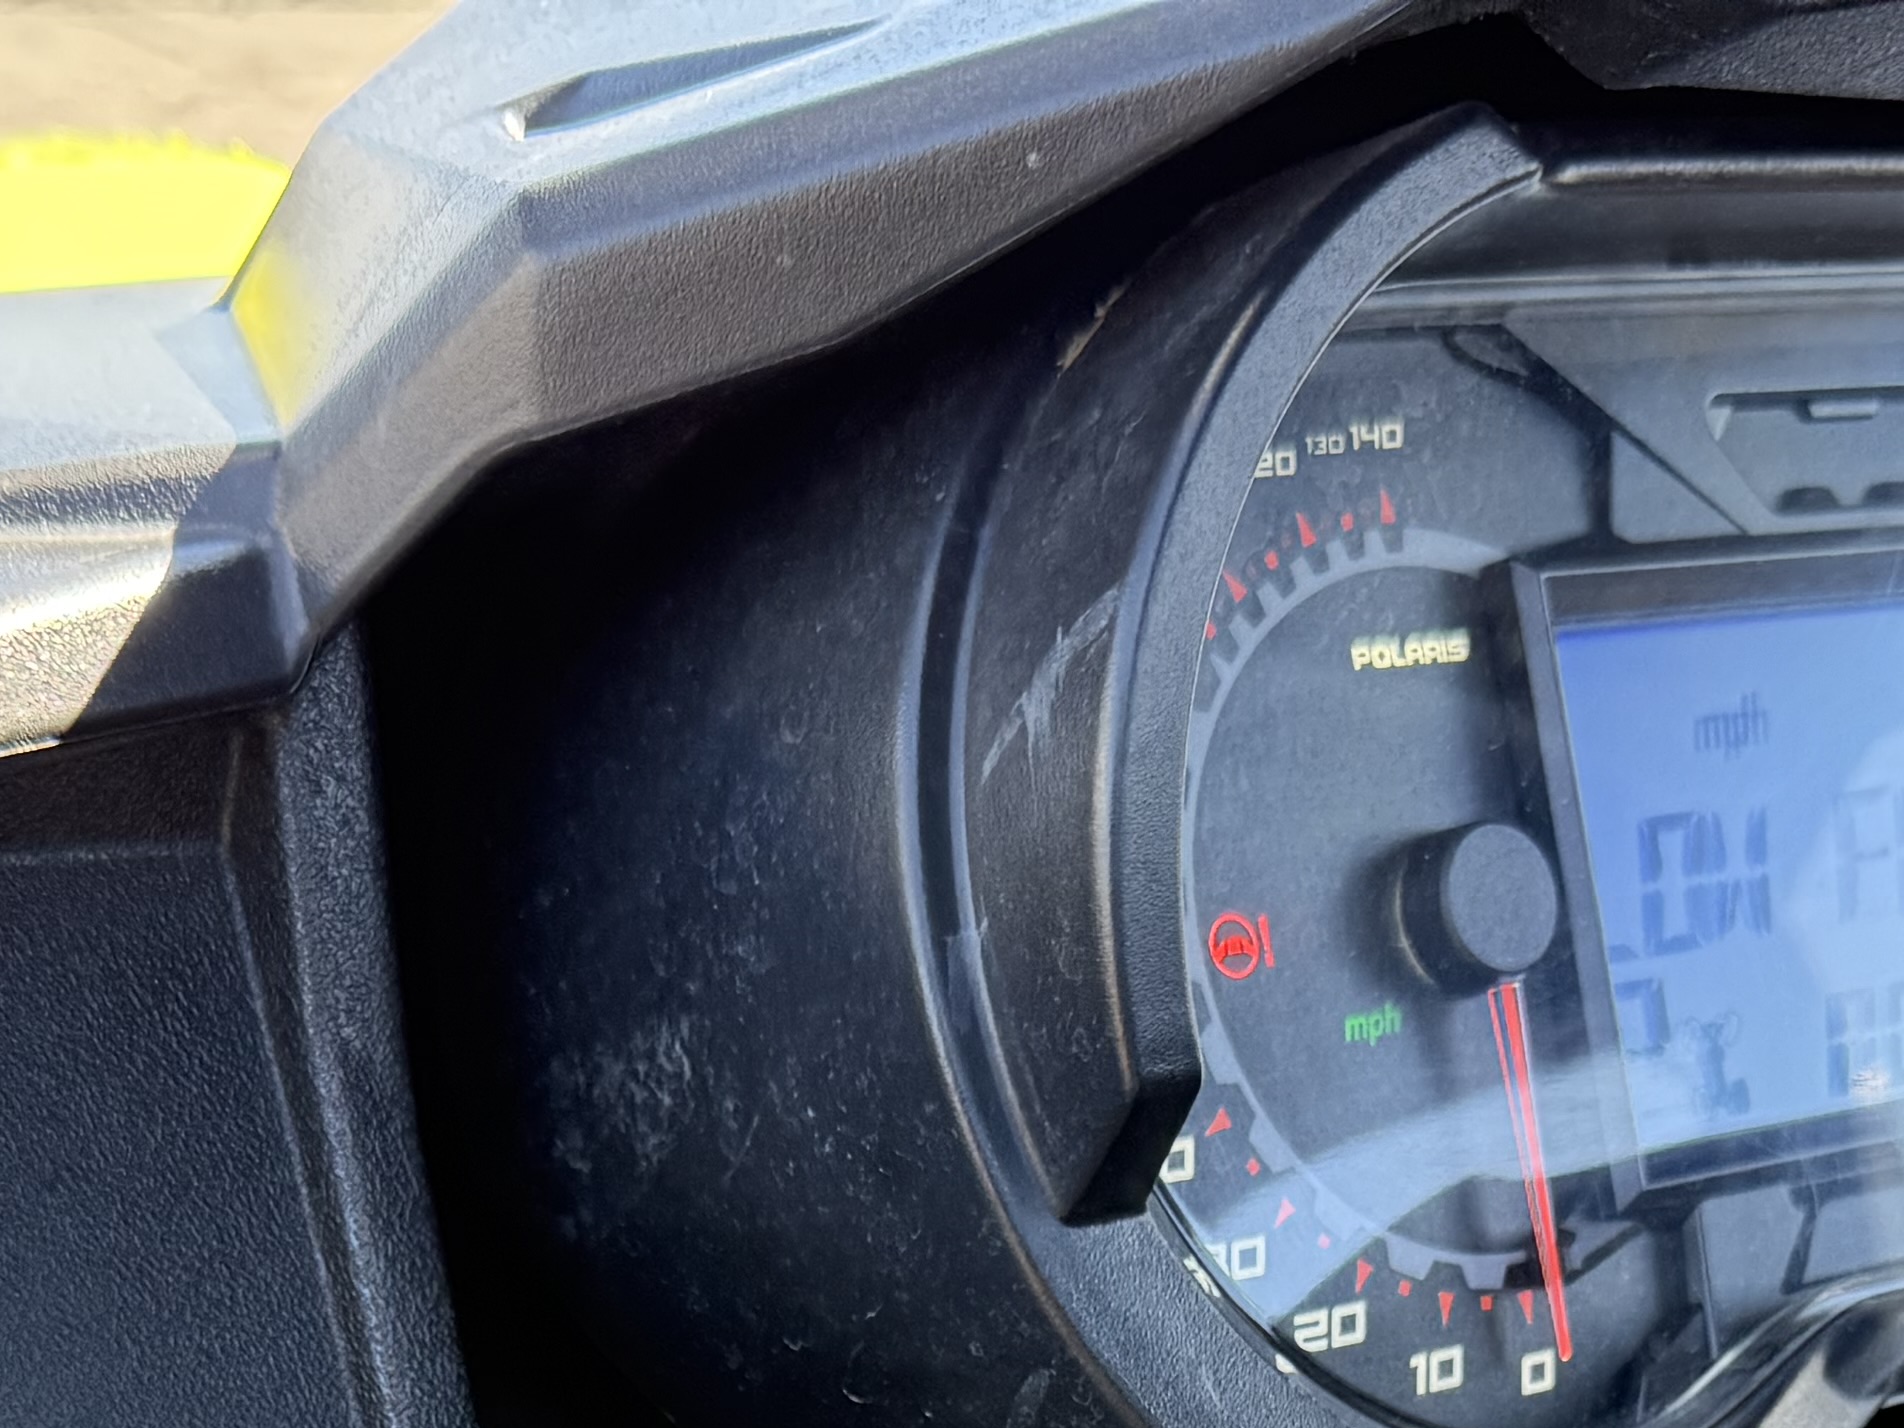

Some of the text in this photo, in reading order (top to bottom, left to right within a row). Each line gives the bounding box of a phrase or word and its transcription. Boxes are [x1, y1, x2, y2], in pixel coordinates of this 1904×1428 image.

[1304, 432, 1346, 456] 130
[1349, 414, 1405, 452] 140
[1254, 444, 1296, 479] 20
[1350, 628, 1471, 672] POLARIS
[1693, 690, 1770, 763] mph
[1344, 1003, 1404, 1046] mph
[1293, 1299, 1368, 1353] 20
[1409, 1344, 1464, 1396] 10
[1520, 1350, 1556, 1397] 0
